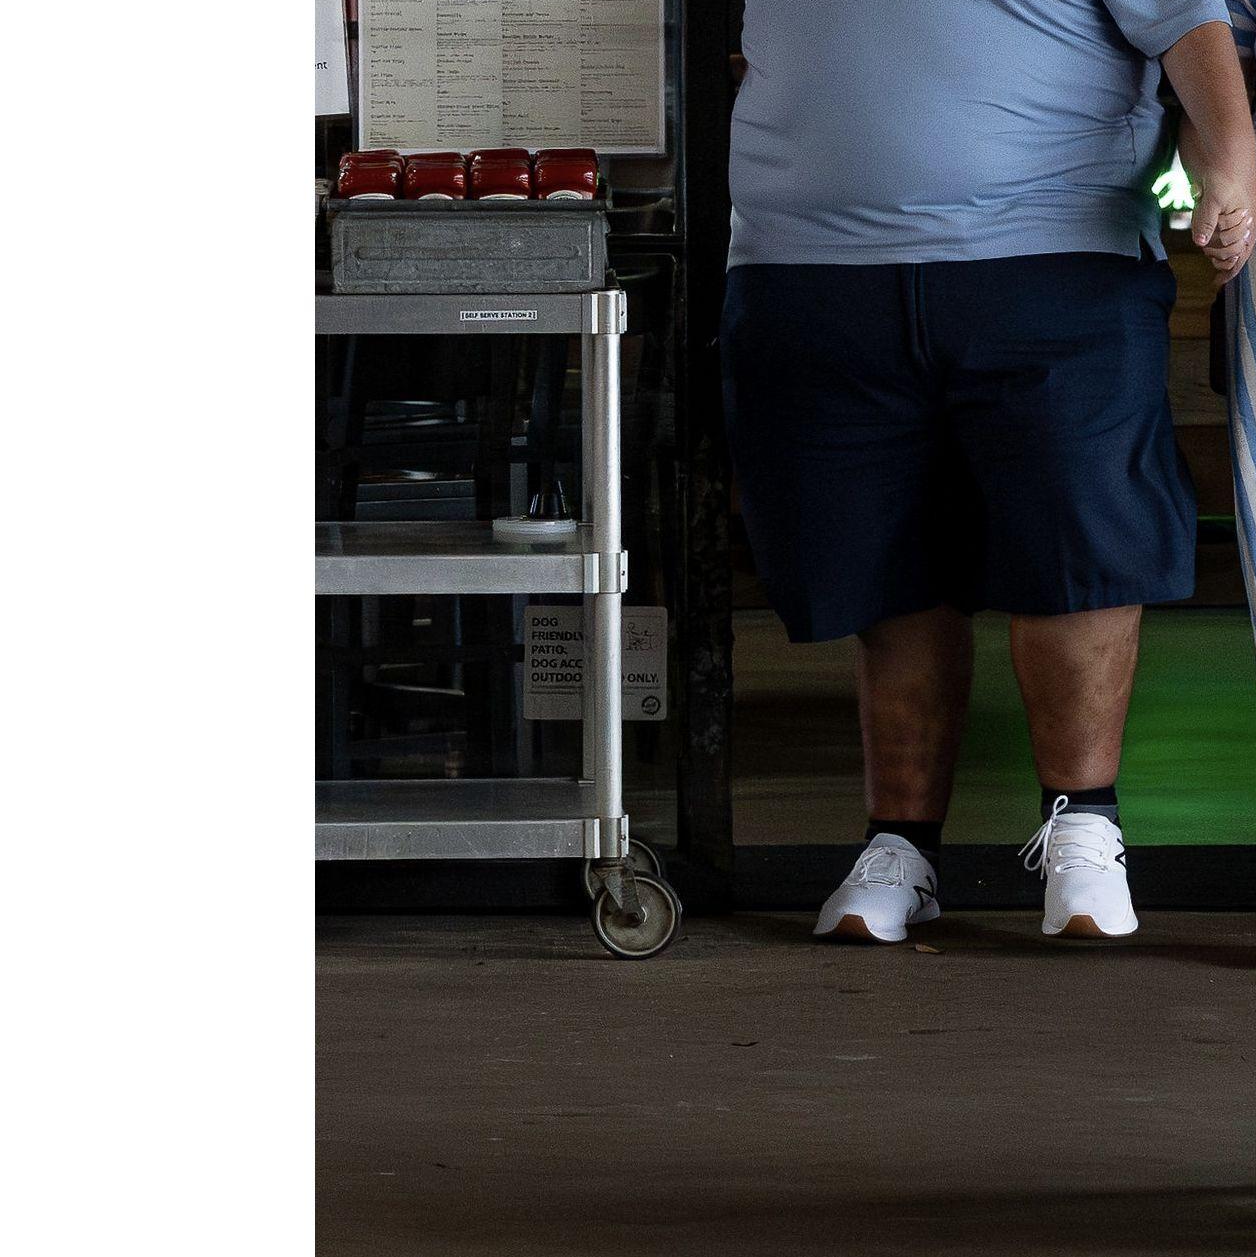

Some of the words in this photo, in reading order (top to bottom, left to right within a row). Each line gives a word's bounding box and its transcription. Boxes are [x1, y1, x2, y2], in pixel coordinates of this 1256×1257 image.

[532, 617, 558, 627] DOG
[531, 659, 557, 669] DOG
[560, 659, 583, 669] ACC
[531, 673, 583, 683] OUTDOO
